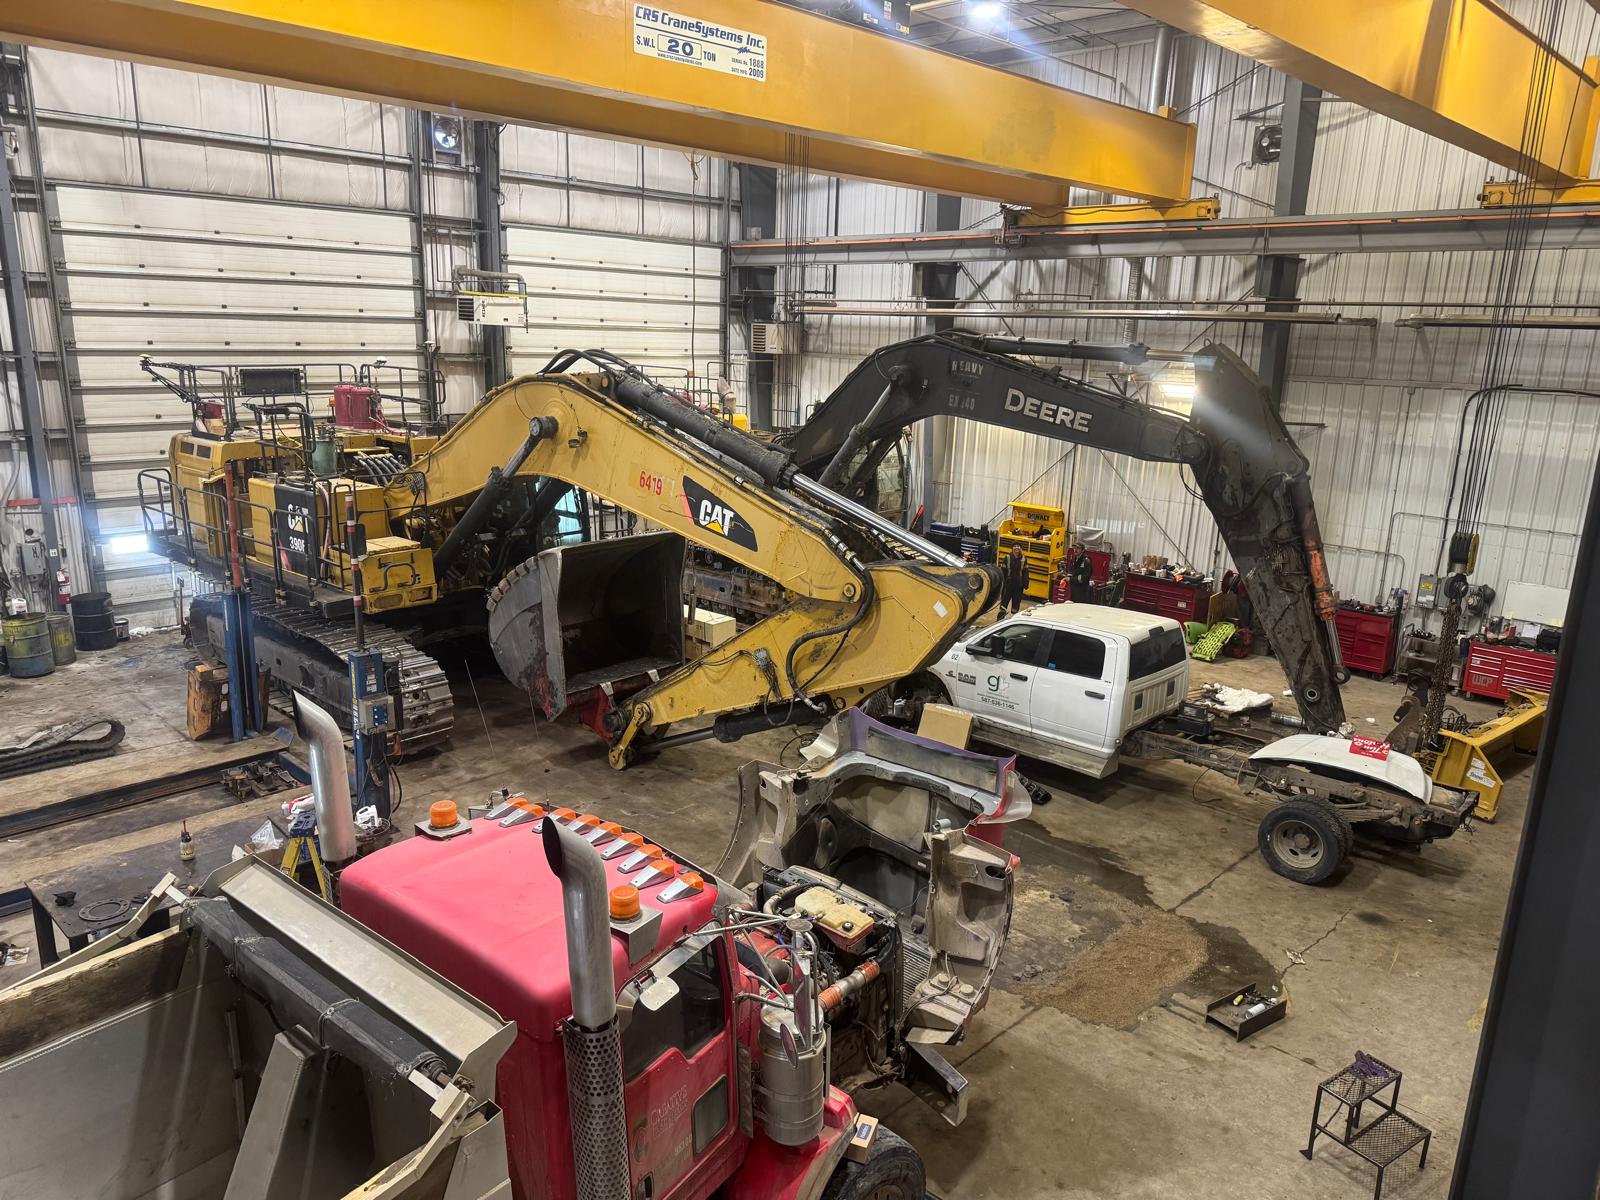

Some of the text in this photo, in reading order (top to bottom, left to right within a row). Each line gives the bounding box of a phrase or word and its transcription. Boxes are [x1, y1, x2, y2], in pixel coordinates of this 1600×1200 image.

[635, 6, 765, 49] CRS CraneSystems Inc.
[636, 35, 656, 48] S.W.L
[667, 38, 694, 56] 20
[702, 50, 716, 62] TON
[749, 67, 764, 79] 2009
[952, 360, 984, 376] HEAVY
[1004, 388, 1093, 433] DEERE
[640, 470, 662, 496] 6419
[288, 504, 308, 534] CAT
[700, 500, 735, 536] CAT
